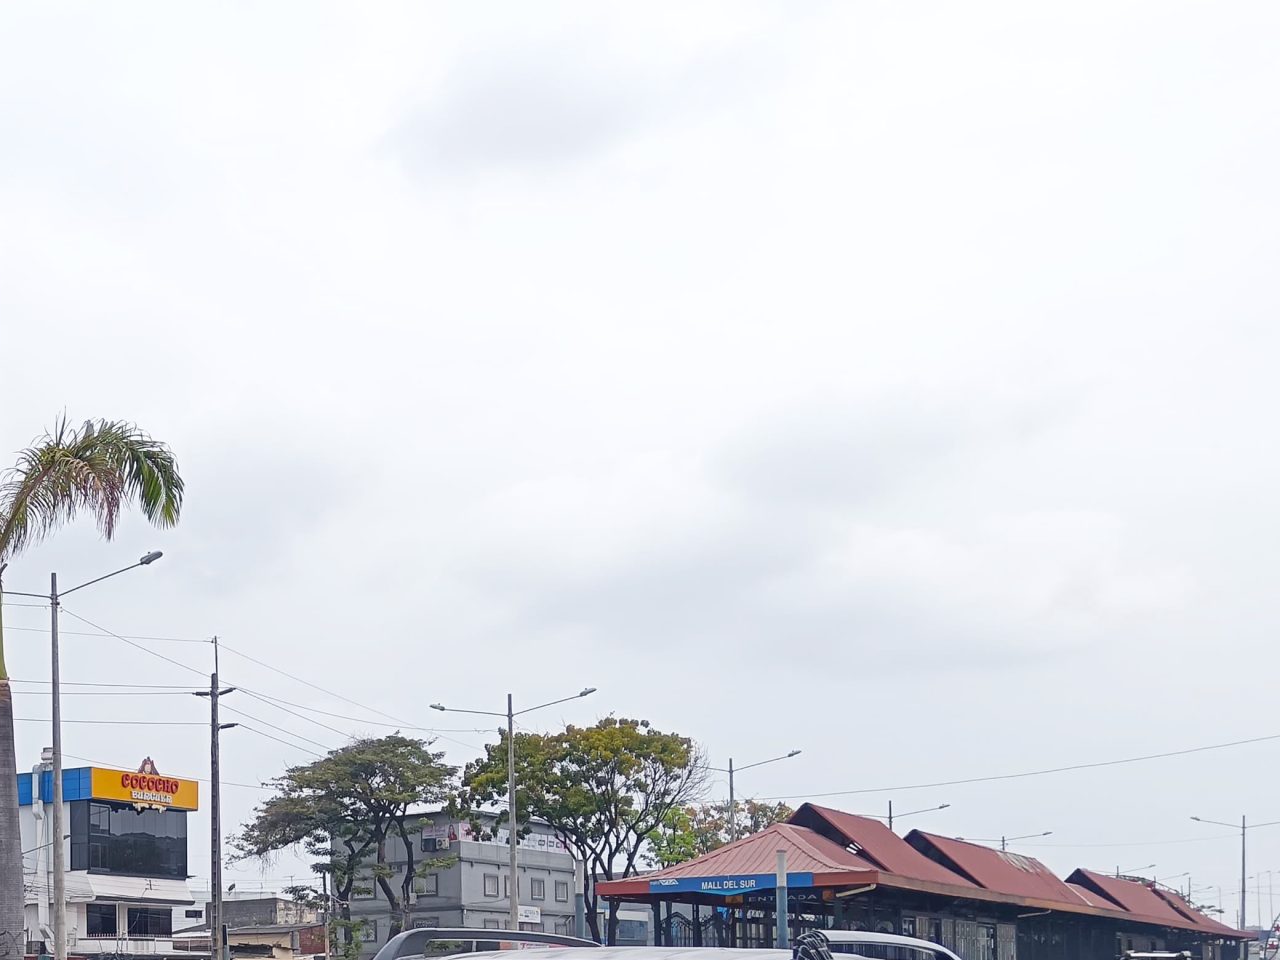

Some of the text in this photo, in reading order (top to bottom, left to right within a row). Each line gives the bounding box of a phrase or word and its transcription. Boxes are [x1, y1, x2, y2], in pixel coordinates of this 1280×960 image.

[701, 879, 756, 890] MALL DEL SUR
[748, 894, 817, 902] ENTADA
